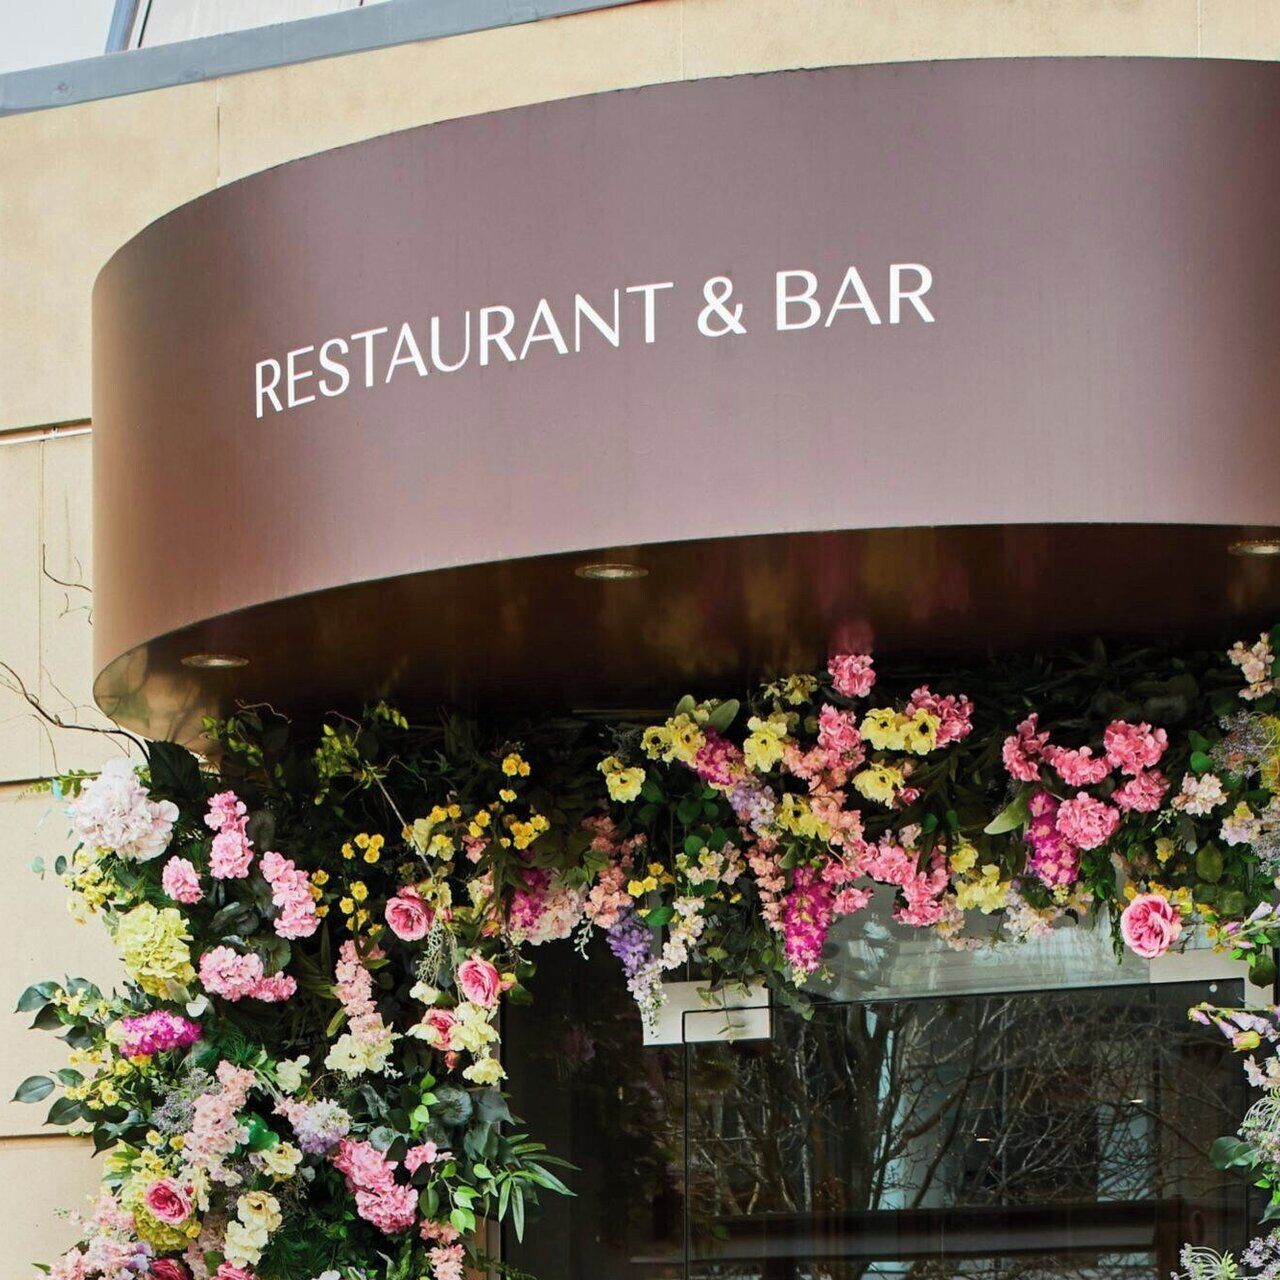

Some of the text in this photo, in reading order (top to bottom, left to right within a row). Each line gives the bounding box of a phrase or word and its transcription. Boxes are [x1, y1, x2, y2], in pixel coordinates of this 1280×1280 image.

[255, 263, 935, 418] RESTAURANT & BAR
